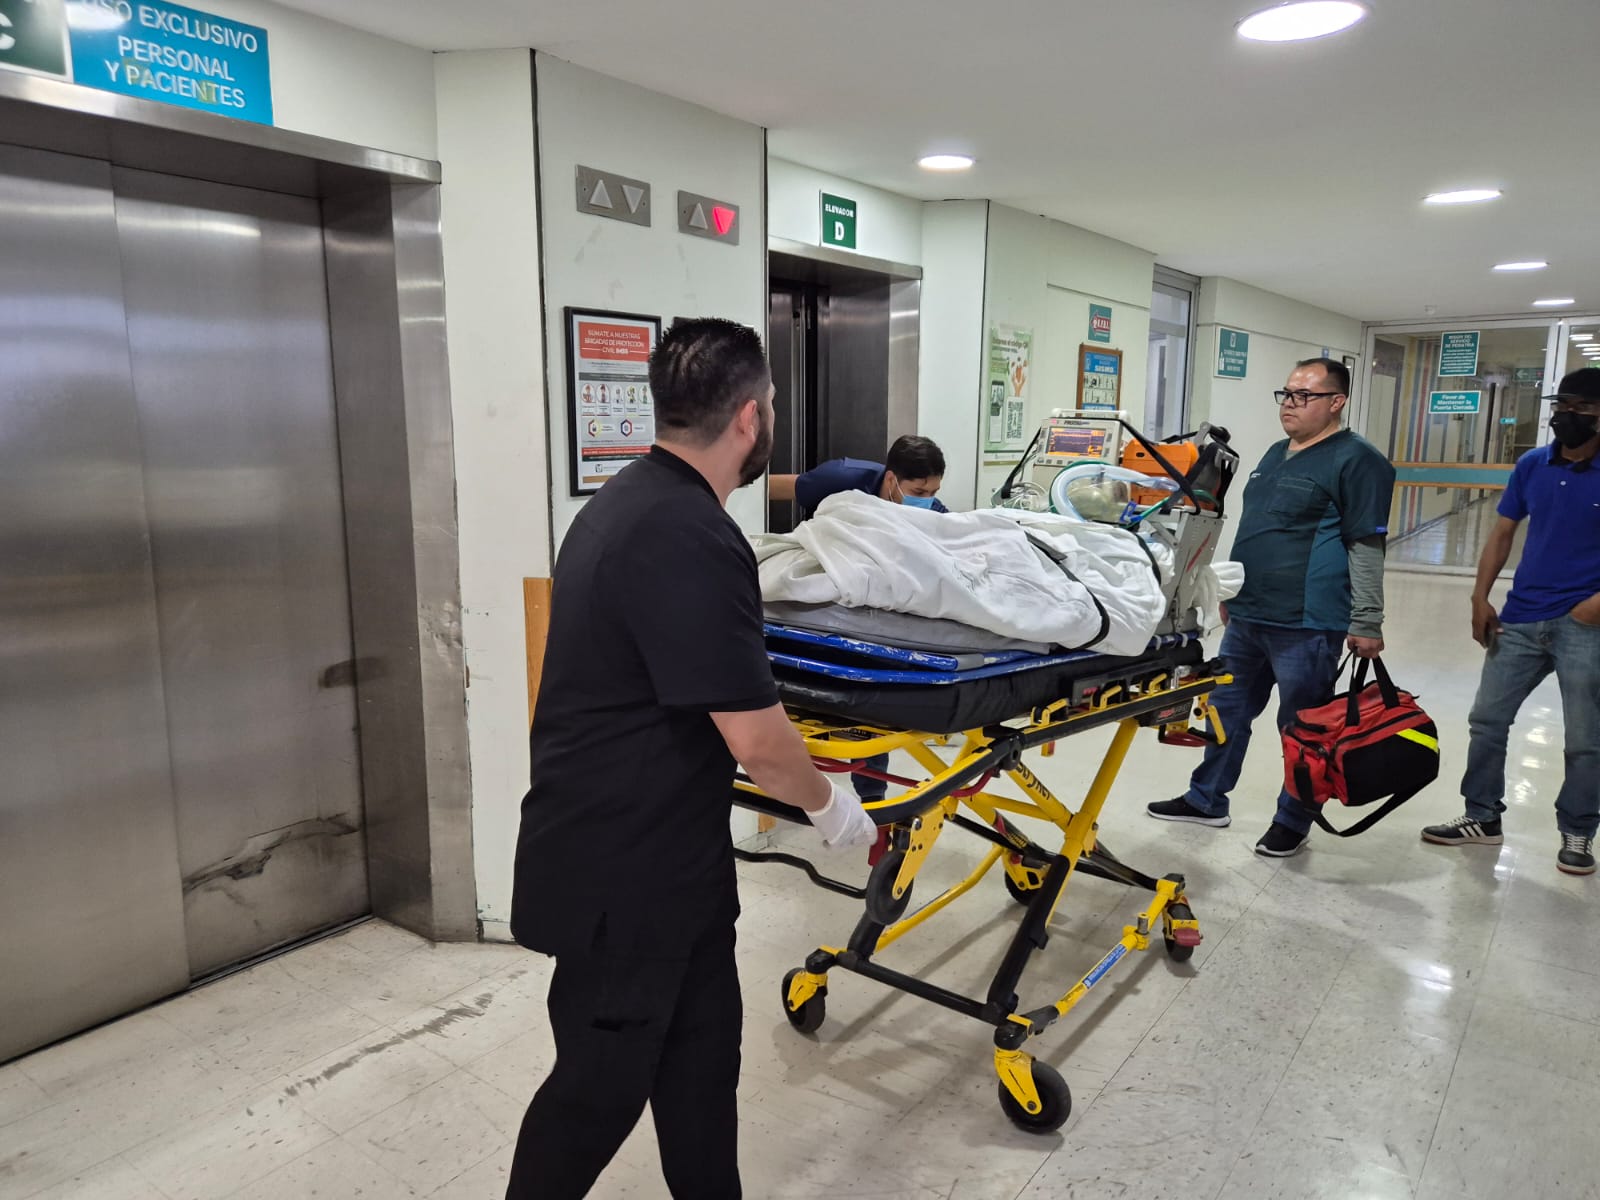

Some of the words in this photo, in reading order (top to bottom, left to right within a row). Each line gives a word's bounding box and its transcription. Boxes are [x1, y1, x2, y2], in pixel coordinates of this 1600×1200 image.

[139, 5, 258, 53] EXCLUSIVO
[118, 35, 236, 82] PERSONAL
[104, 59, 120, 83] Y
[125, 64, 246, 109] PACIENTES
[824, 203, 854, 218] ELEVADOR
[834, 221, 845, 241] D
